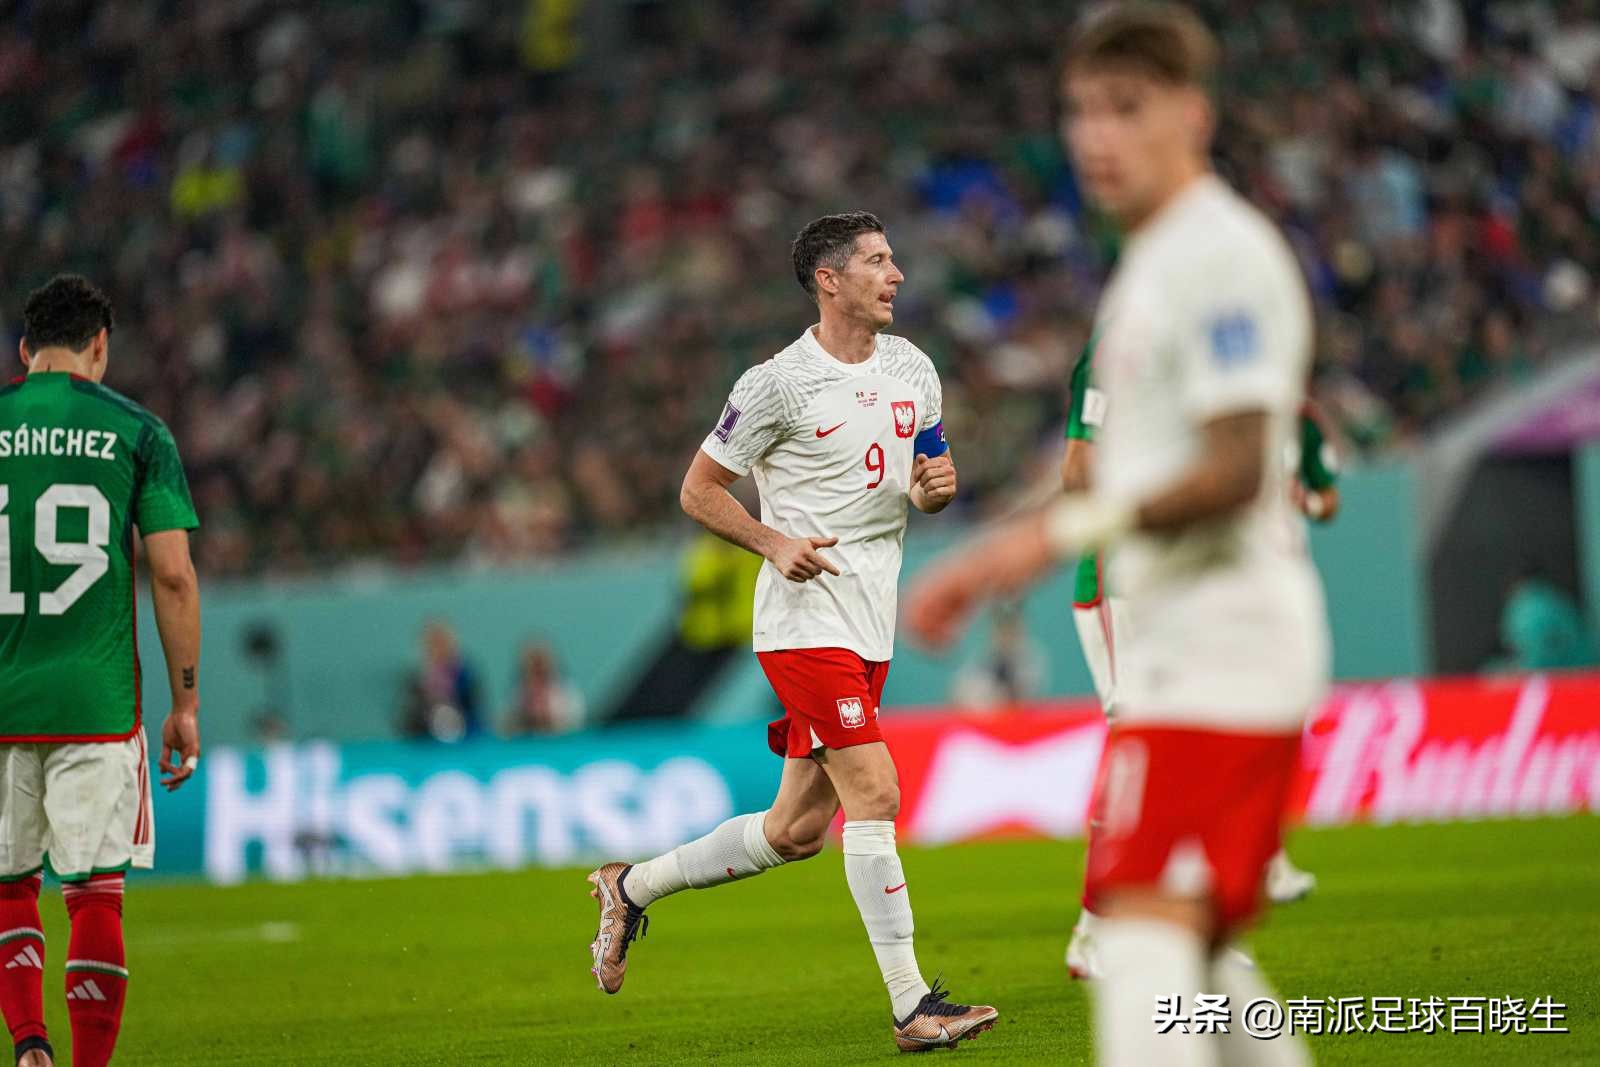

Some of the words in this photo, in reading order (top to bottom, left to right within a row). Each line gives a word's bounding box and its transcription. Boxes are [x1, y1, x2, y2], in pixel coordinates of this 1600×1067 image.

[0, 423, 118, 461] SÁNCHEZ
[865, 442, 886, 490] 9
[204, 740, 732, 884] Hisense
